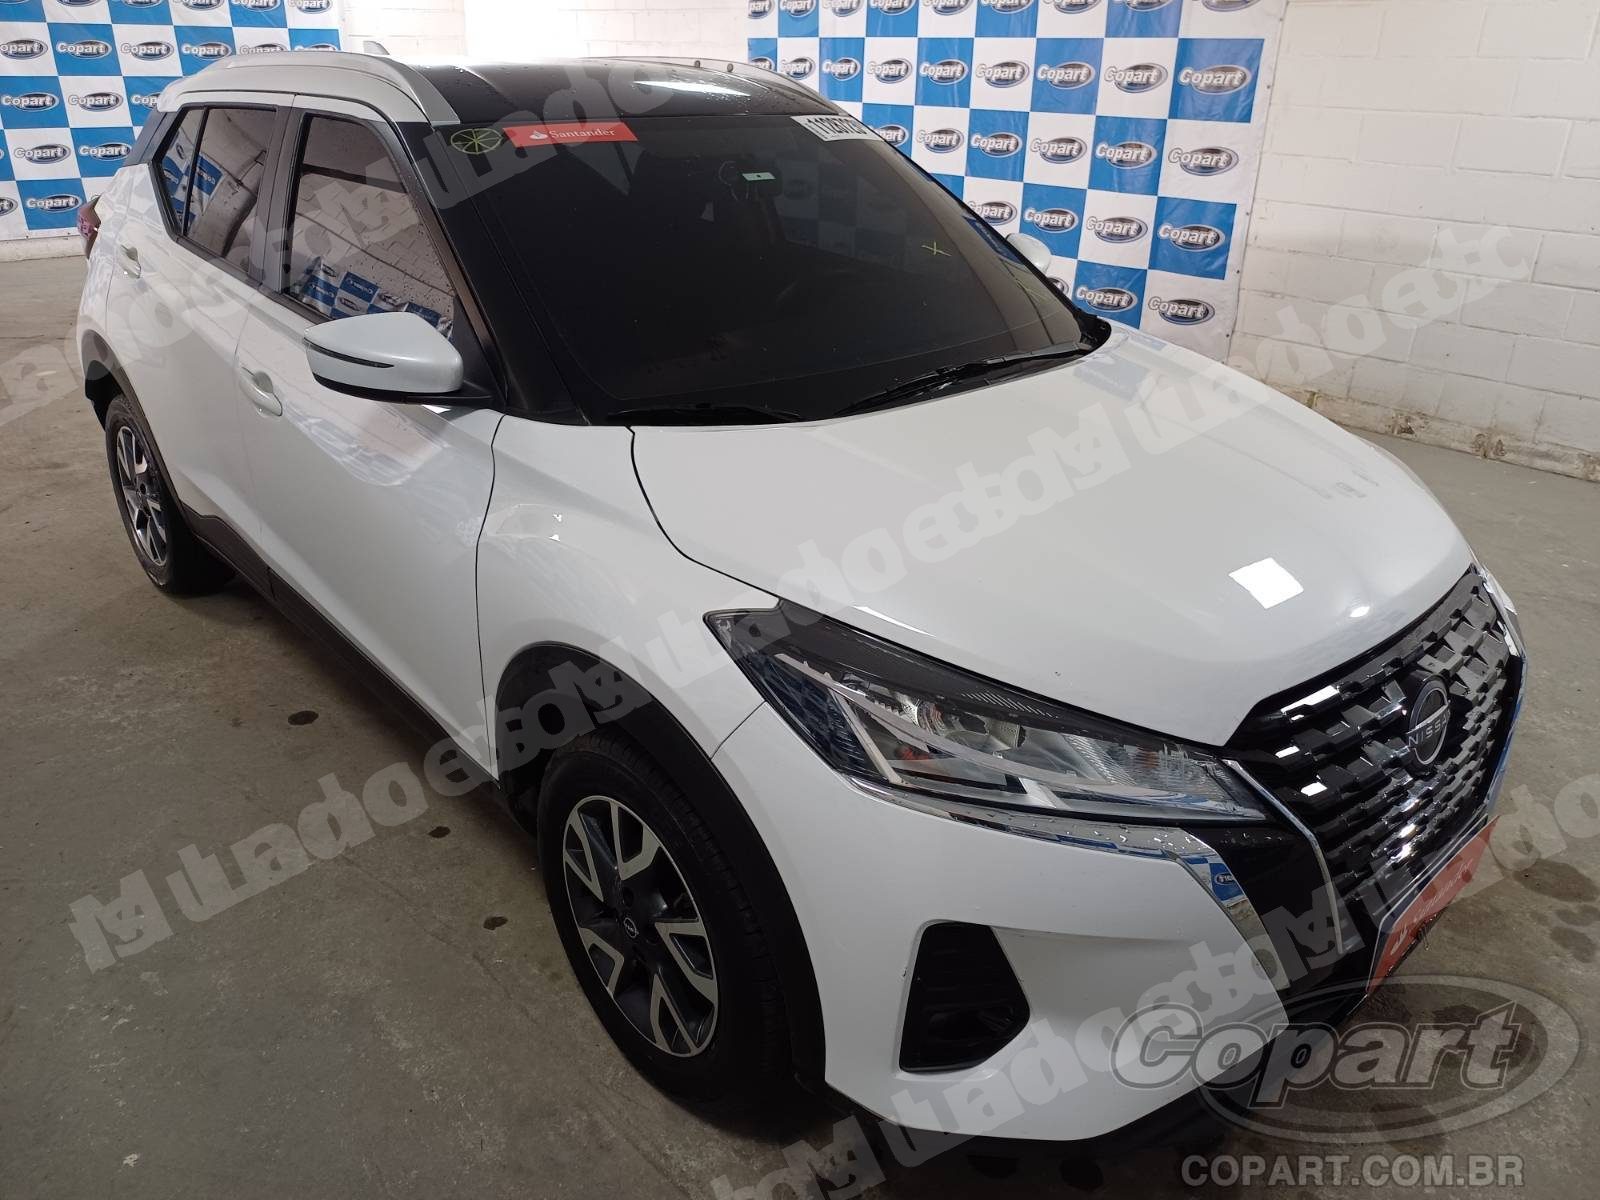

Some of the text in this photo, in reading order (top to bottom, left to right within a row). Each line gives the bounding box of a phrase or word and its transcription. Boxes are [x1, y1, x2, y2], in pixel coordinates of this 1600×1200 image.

[749, 0, 769, 12] part
[0, 42, 41, 55] opart
[57, 42, 105, 55] Copart
[121, 43, 167, 56] Copart
[182, 44, 226, 57] Copart
[781, 60, 811, 75] Copart
[822, 60, 856, 76] Copart
[867, 61, 907, 78] Copart
[919, 62, 962, 80] Copart
[976, 64, 1022, 81] Copart
[1037, 64, 1088, 83] Copart
[1104, 66, 1159, 85] Copart
[1179, 67, 1243, 88] Copart
[2, 95, 52, 108] Copart
[68, 95, 116, 108] Copart
[131, 95, 157, 107] Cop
[549, 128, 617, 139] Santander
[879, 128, 904, 142] part
[916, 130, 958, 147] Copart
[970, 133, 1016, 152] Copart
[1030, 138, 1079, 158] Copart
[14, 147, 66, 160] Copart
[79, 145, 127, 159] Copart
[1095, 142, 1147, 163] Copart
[1168, 148, 1229, 168] Copart
[26, 197, 77, 211] Copart
[1024, 208, 1073, 227] Copart
[1087, 216, 1140, 236] Copart
[1158, 224, 1216, 246] Copart
[1076, 286, 1130, 308] Copart
[1148, 297, 1205, 319] Copart
